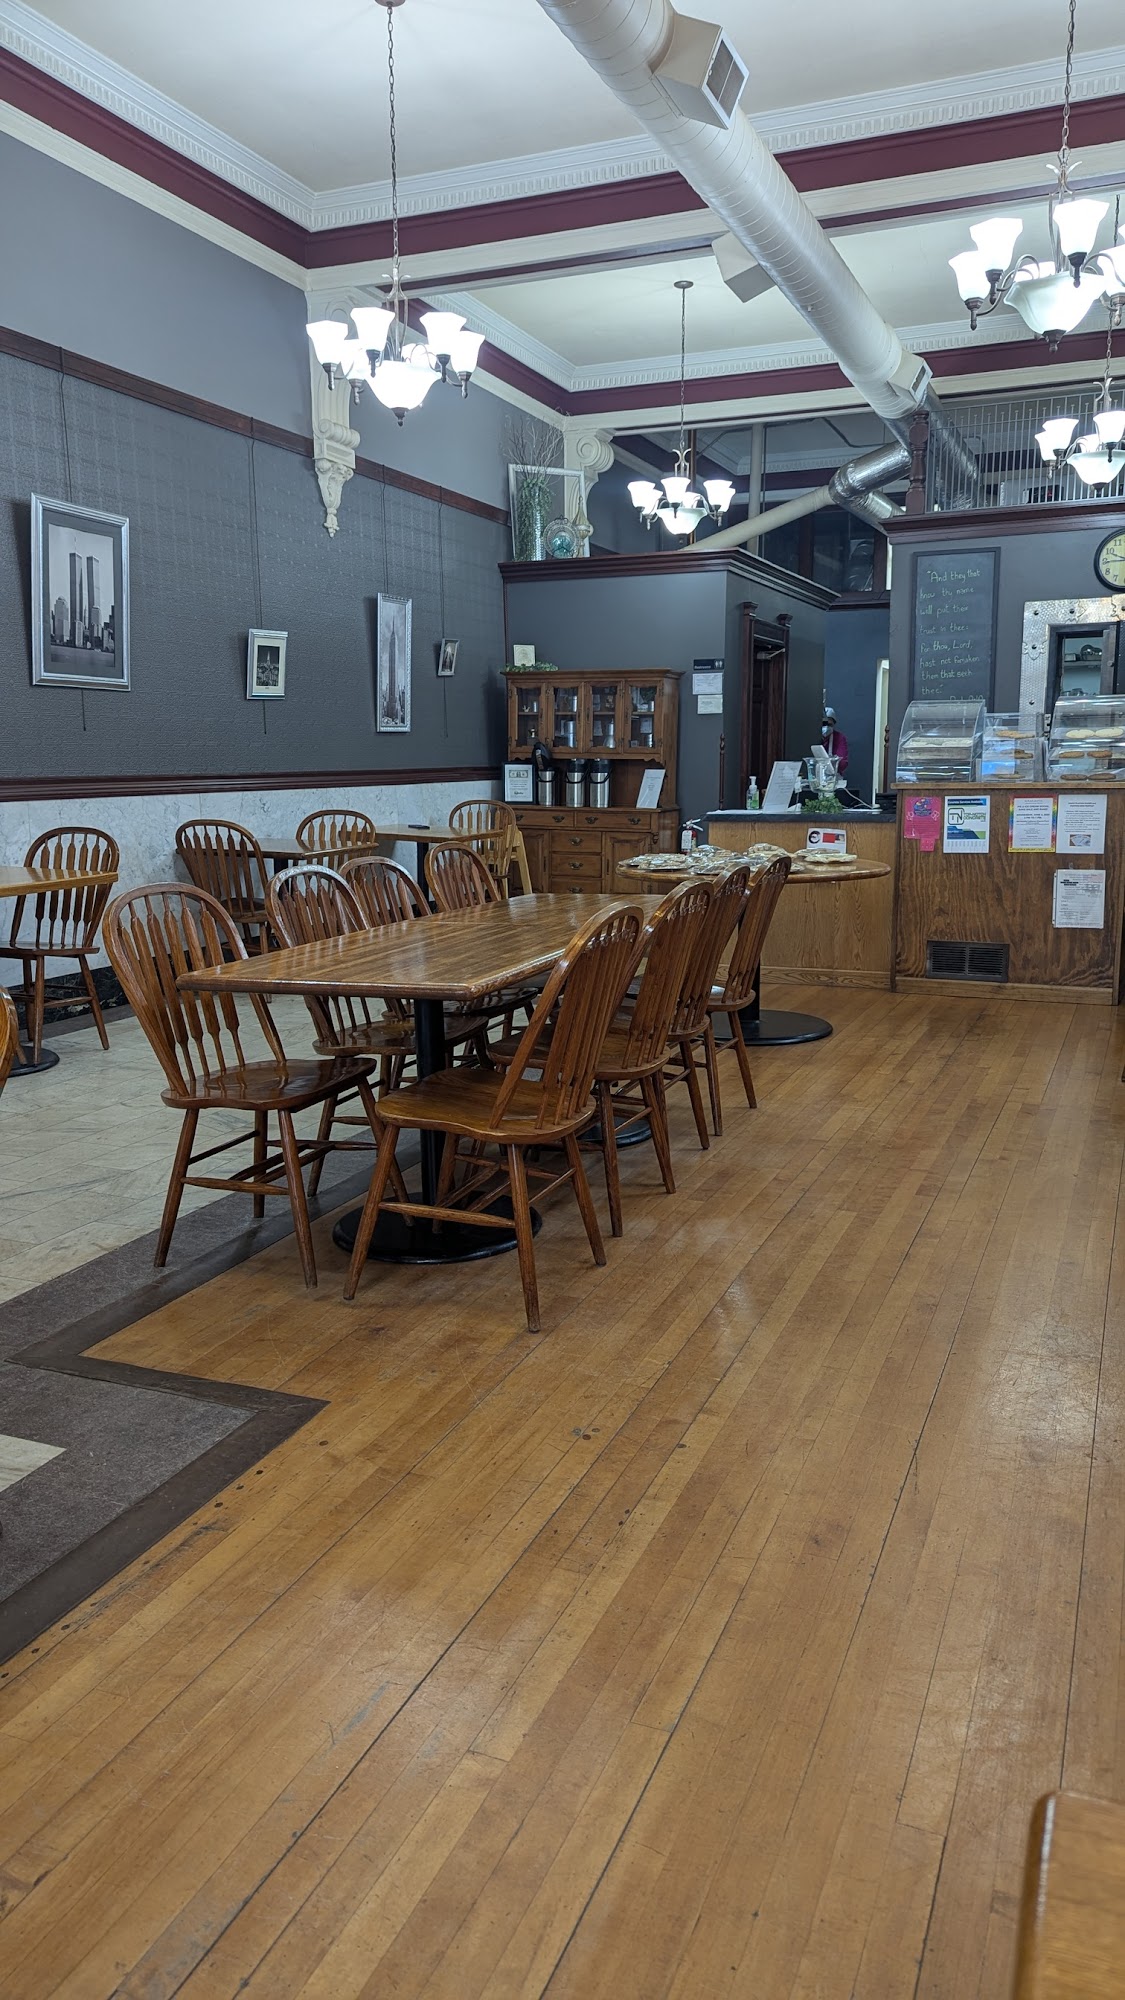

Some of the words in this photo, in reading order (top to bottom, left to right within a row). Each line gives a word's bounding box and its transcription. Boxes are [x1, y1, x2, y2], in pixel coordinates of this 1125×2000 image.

[1113, 539, 1122, 547] 11
[1106, 547, 1115, 555] 10
[950, 571, 966, 583] they
[1113, 574, 1118, 582] 7
[953, 639, 973, 650] Lord,
